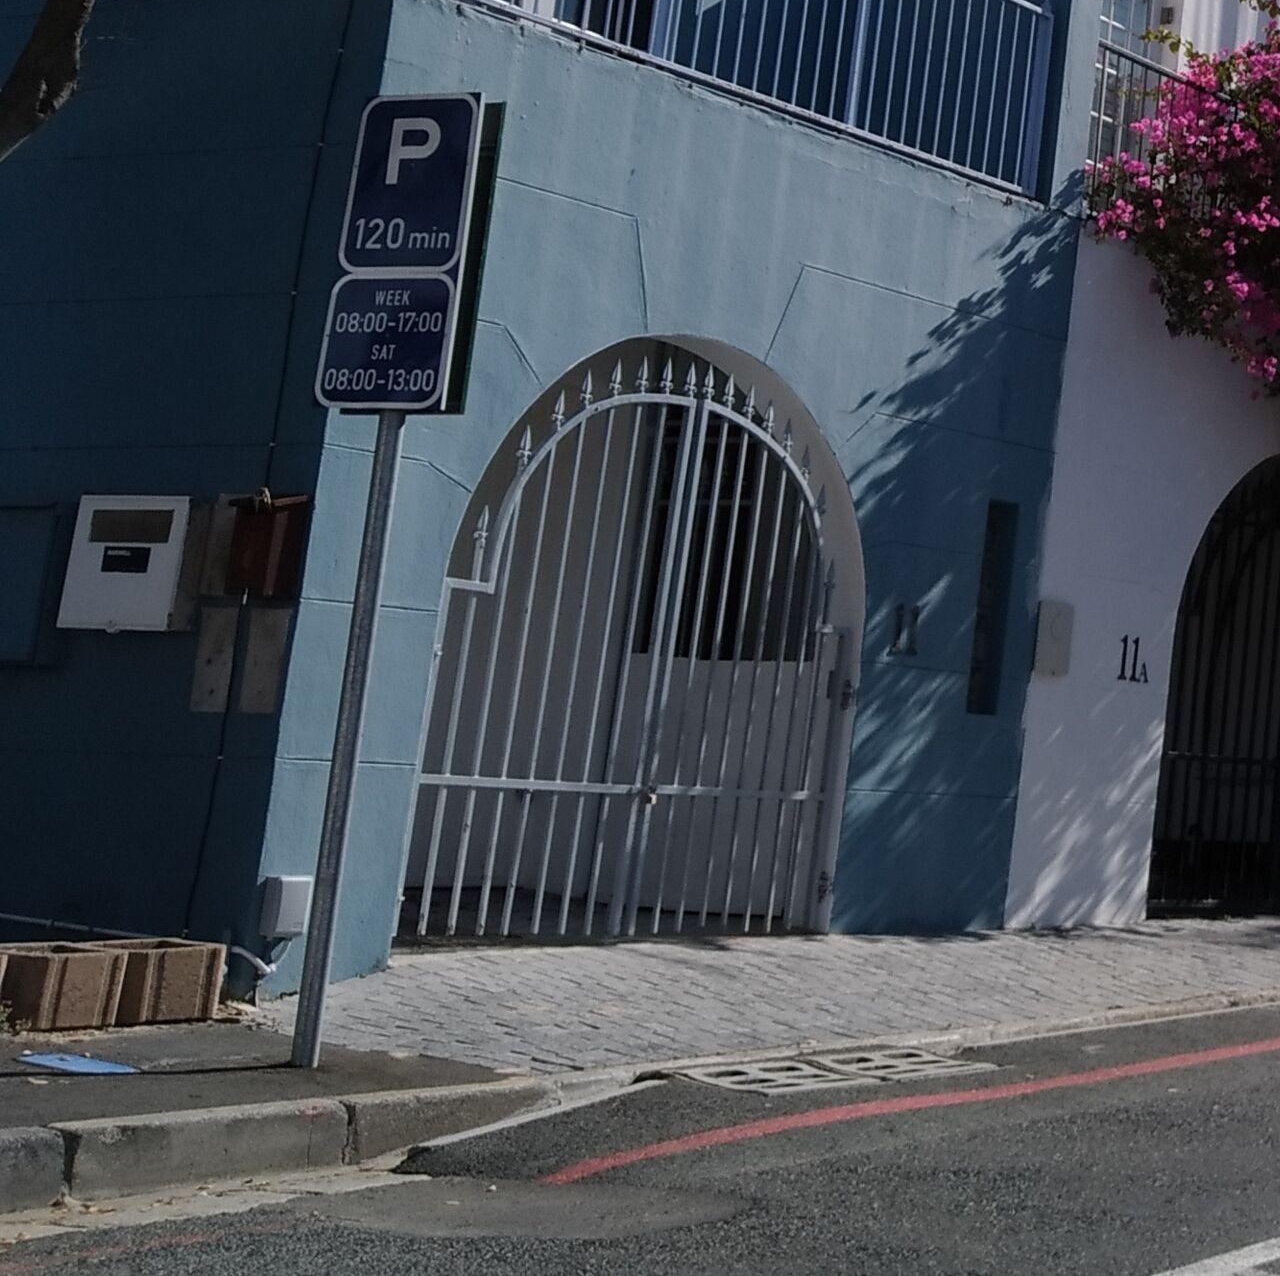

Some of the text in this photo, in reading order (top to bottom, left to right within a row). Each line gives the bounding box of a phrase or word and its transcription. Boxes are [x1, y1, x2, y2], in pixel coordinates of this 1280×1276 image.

[384, 117, 442, 185] P
[354, 217, 451, 250] 120 min
[375, 289, 412, 307] WEEK
[335, 311, 443, 334] 08:00-17:00
[371, 343, 396, 361] SAT
[323, 367, 435, 392] 08:00-13:00
[1117, 634, 1149, 684] 11A
